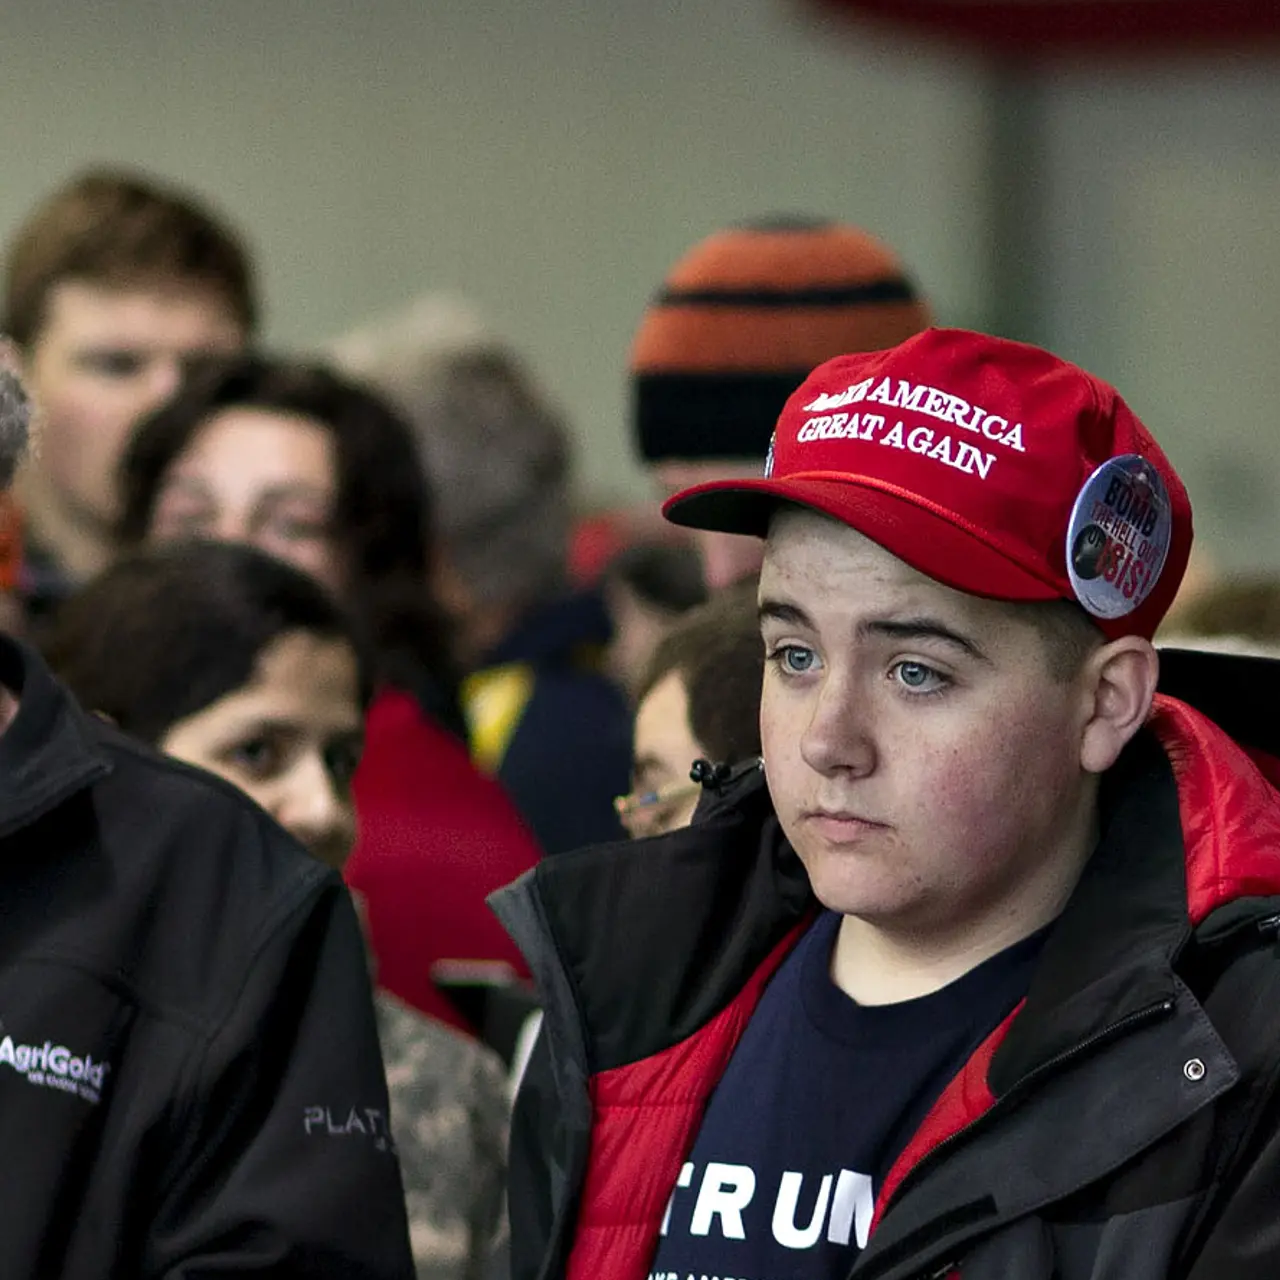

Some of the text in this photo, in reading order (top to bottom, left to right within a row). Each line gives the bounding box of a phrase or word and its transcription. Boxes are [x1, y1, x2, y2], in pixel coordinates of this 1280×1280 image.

[866, 376, 1027, 452] AMERICA
[796, 412, 998, 480] GREAT AGAIN
[1104, 474, 1159, 537] BOMB
[0, 1035, 104, 1089] AgriGold
[303, 1106, 384, 1135] PLAT
